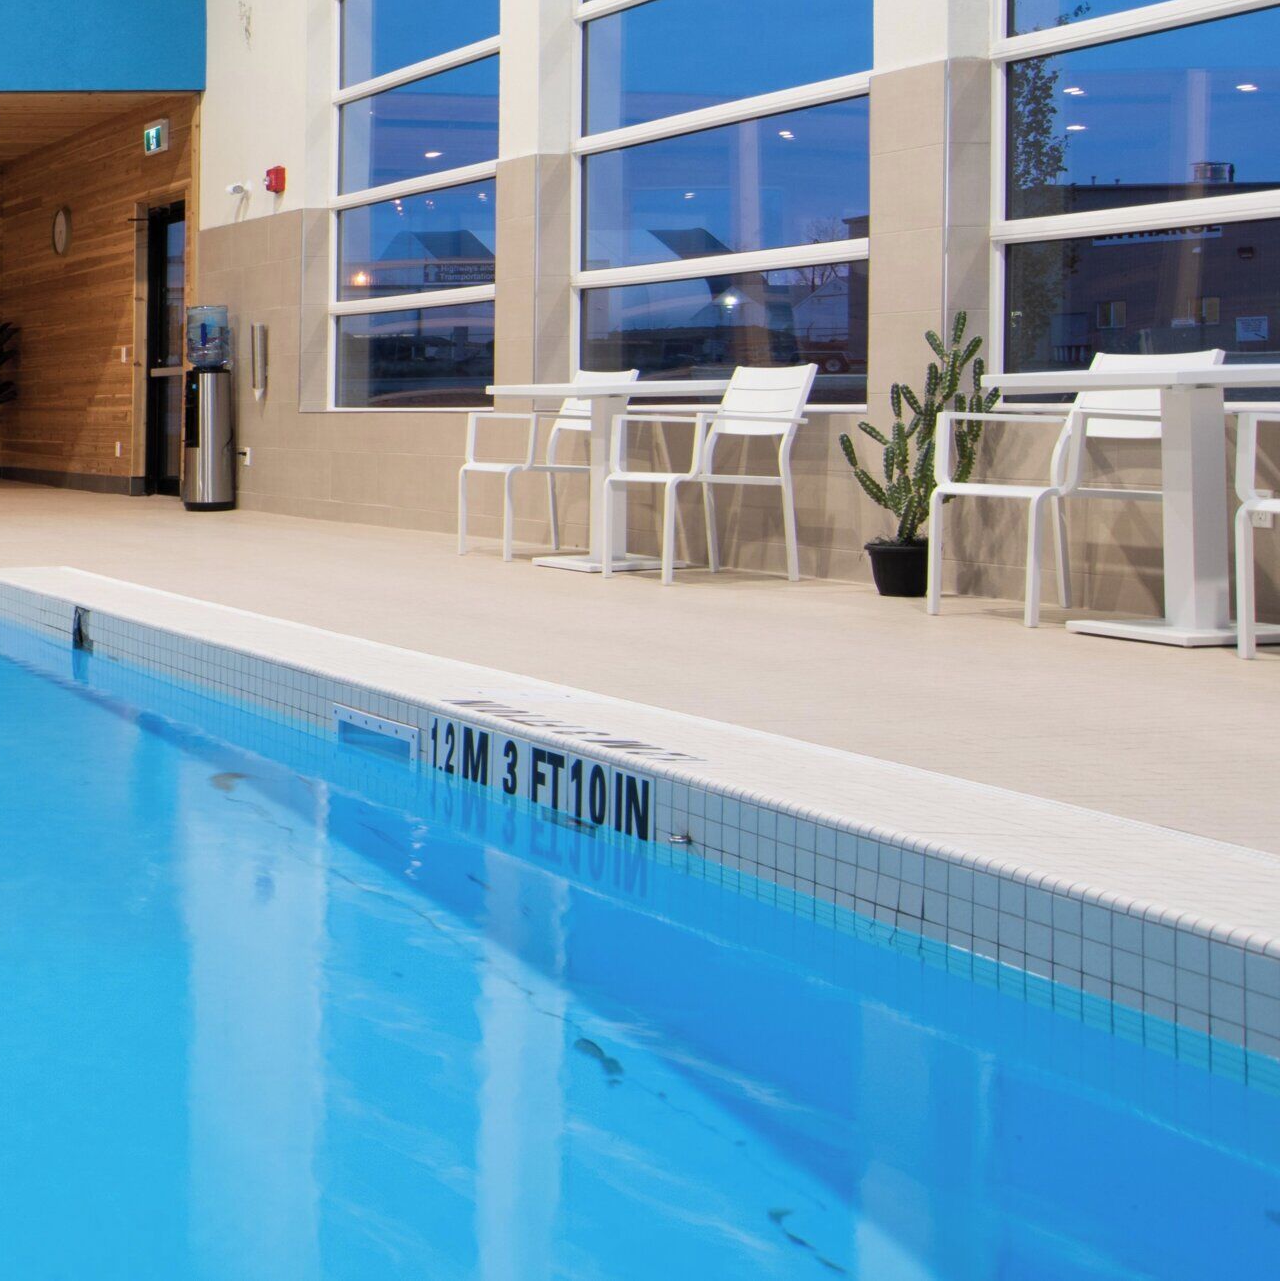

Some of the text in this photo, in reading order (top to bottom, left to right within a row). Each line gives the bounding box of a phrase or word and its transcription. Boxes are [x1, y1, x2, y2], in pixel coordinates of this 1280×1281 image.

[431, 717, 650, 842] 1.2 M 3 FT 10 IN
